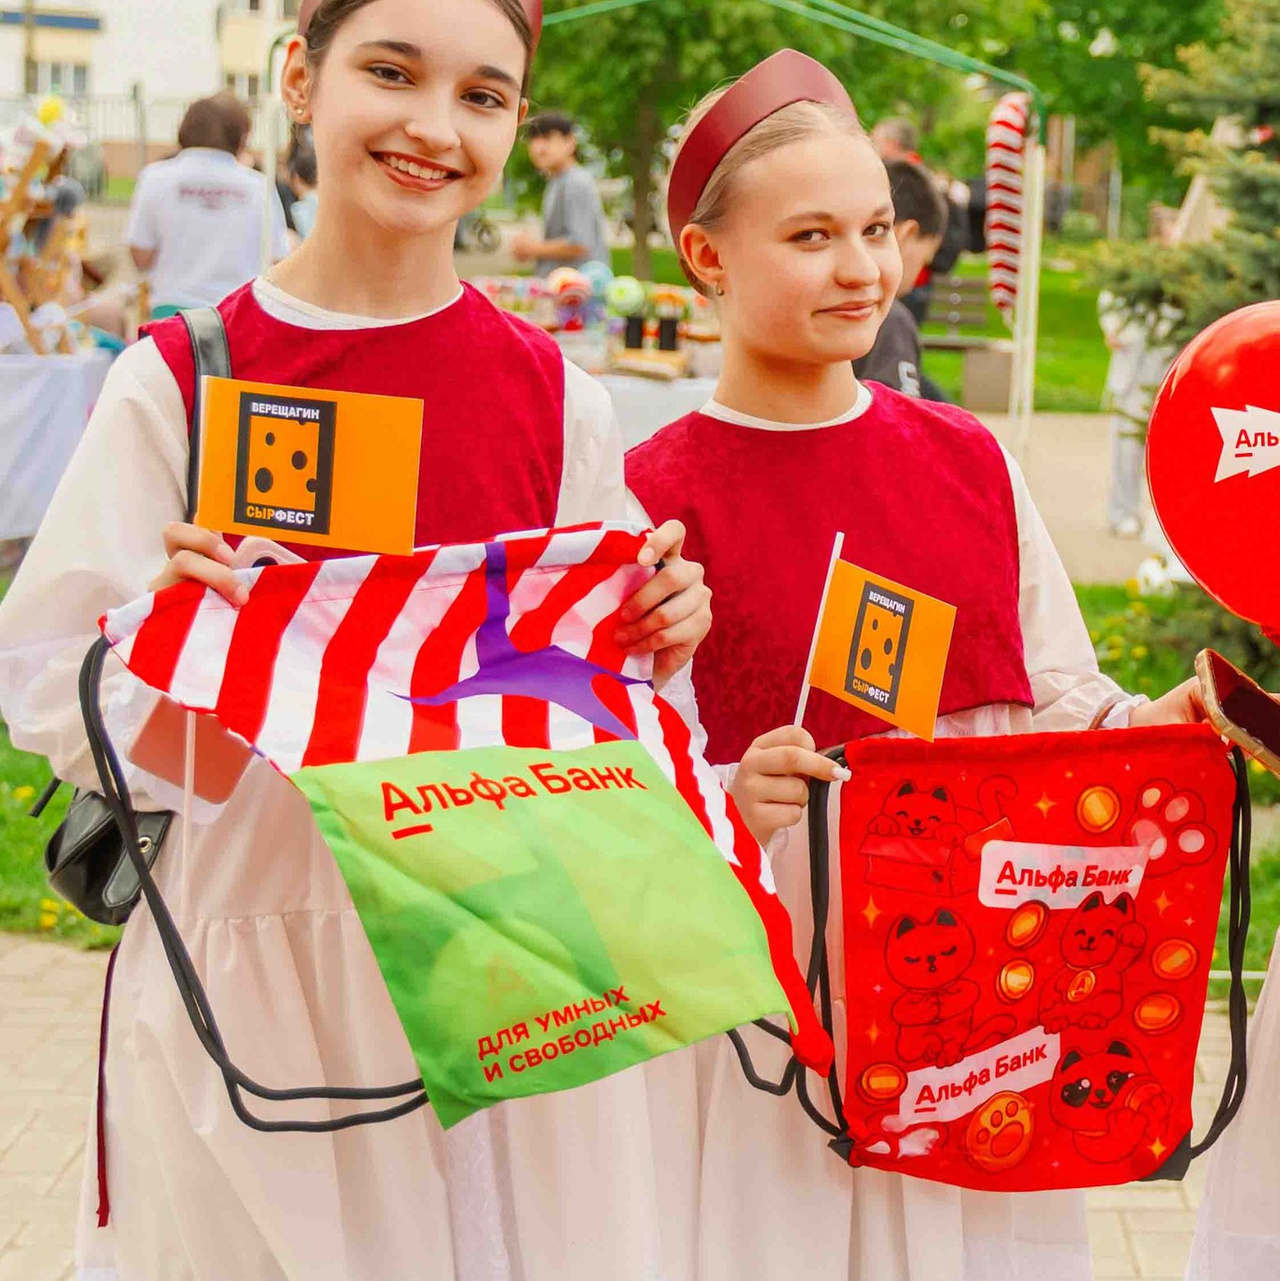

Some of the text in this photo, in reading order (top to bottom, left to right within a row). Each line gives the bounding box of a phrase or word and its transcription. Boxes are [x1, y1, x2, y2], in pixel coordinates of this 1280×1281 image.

[251, 401, 320, 420] ВЕРЕЩАГИН
[245, 505, 315, 526] СЫРФЕСТ
[868, 590, 906, 614] ВЕРЕЩАГИН
[852, 678, 890, 704] СЫРФЕСТ
[380, 762, 649, 840] Альфа Банк
[994, 860, 1133, 896] Альфа Банк
[483, 999, 667, 1083] И СВОБОДНЫХ
[914, 1043, 1048, 1114] Альфа Банк
